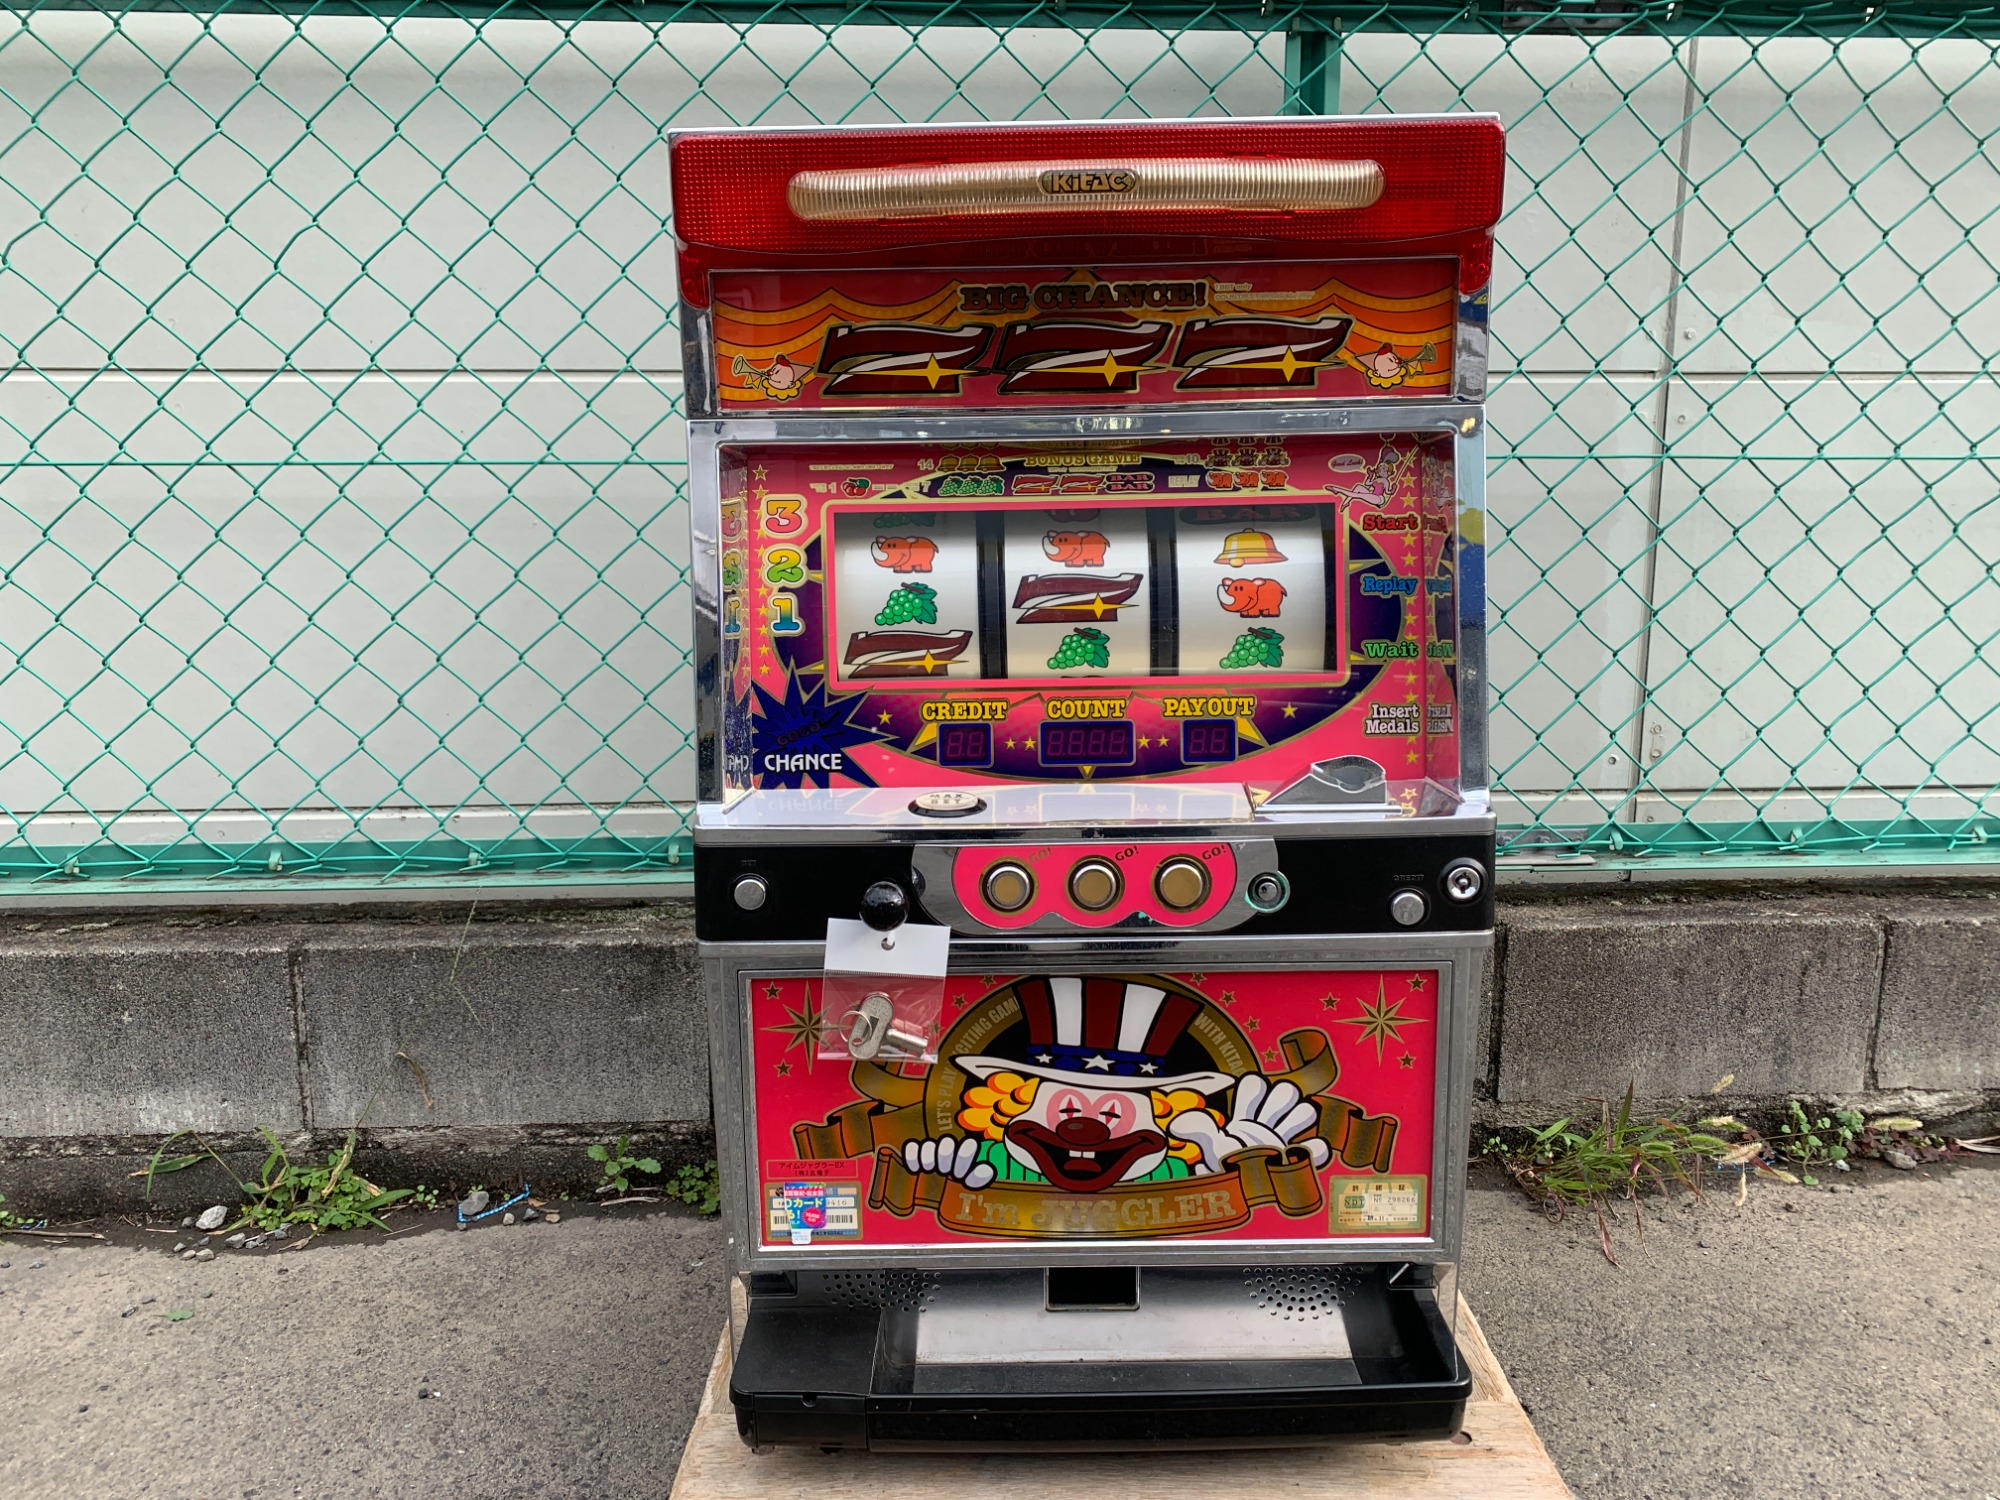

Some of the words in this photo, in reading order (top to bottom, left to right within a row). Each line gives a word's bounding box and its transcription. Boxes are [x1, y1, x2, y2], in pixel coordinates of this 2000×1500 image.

[959, 285, 1030, 313] BIG
[1035, 281, 1207, 311] CHANCE!
[918, 459, 934, 470] 14
[1025, 455, 1086, 466] BONUS
[1087, 453, 1142, 465] GAME
[1170, 476, 1199, 486] REPLAY
[766, 500, 802, 533] 3
[1363, 514, 1418, 531] Start
[767, 549, 803, 583] 2
[1363, 576, 1418, 595] Replay
[773, 598, 800, 631] 1
[1365, 642, 1418, 657] Wait
[922, 701, 1007, 720] CREDIT
[1047, 698, 1126, 718] COUNT
[1164, 696, 1253, 717] PAYOUT
[1372, 704, 1419, 718] Insert
[1365, 719, 1420, 733] Medals
[764, 754, 843, 773] CHANCE
[1028, 847, 1052, 863] GO!
[1114, 845, 1139, 862] GO!
[1201, 844, 1226, 860] GO!
[988, 996, 1021, 1024] GAM
[1194, 1012, 1227, 1046] WITH
[938, 1067, 957, 1097] PLAY
[937, 1099, 953, 1132] LET'S
[955, 1192, 1021, 1225] I'm
[1031, 1189, 1237, 1231] JUGGLER
